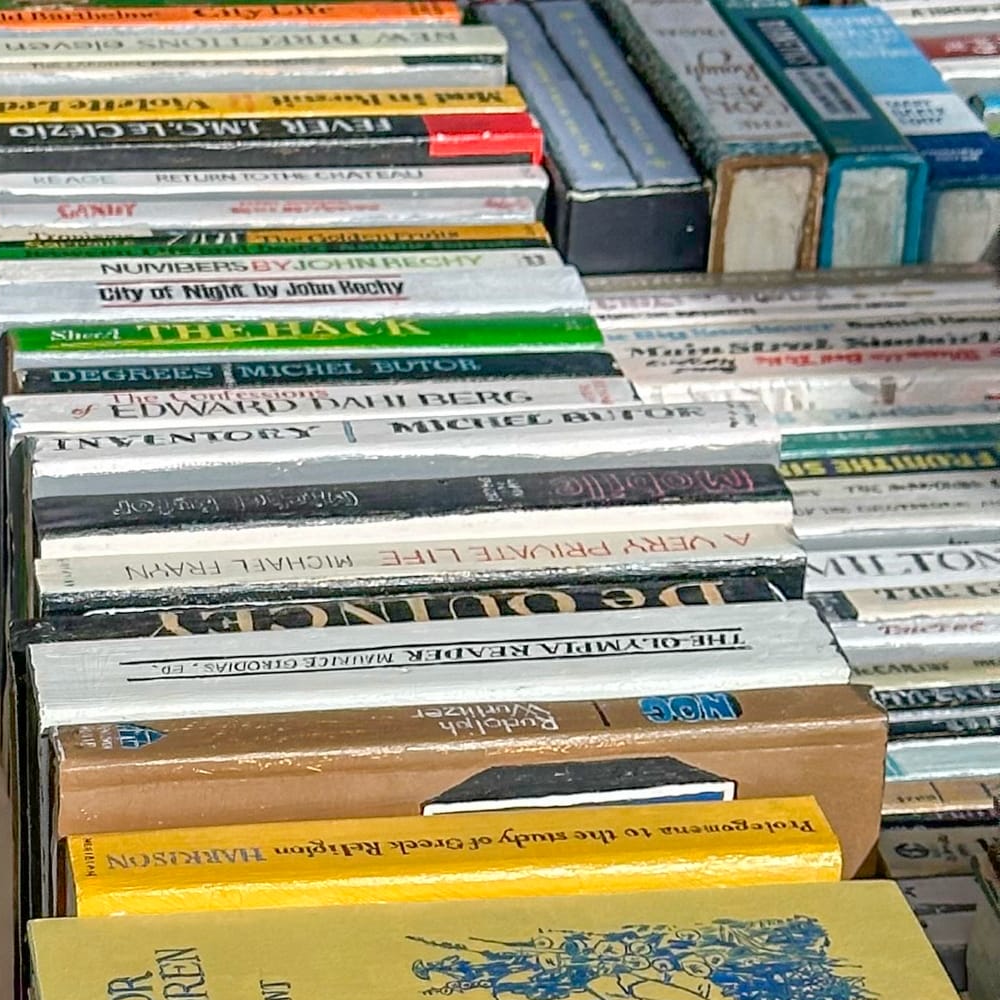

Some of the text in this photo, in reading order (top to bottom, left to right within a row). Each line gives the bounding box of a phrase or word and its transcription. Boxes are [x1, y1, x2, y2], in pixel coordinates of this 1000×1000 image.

[135, 33, 362, 53] DIRECTIONS
[376, 30, 459, 46] NEW
[283, 115, 393, 134] FEVER
[100, 254, 485, 276] NUMBERS BY JOHN RECHY
[98, 282, 145, 304] City
[149, 281, 175, 300] of
[182, 282, 247, 303] Night
[252, 280, 283, 301] by
[284, 279, 337, 298] John
[136, 318, 432, 344] THE HACK
[49, 356, 484, 385] DEGREES MICHEL BUTOR
[109, 396, 298, 421] EDWARD
[53, 424, 322, 451] INVENTORY
[391, 411, 546, 436] MICHEL
[469, 539, 614, 562] PRIVATE
[624, 535, 719, 558] VERY
[727, 532, 753, 552] A
[377, 548, 462, 568] LIFE
[539, 635, 682, 656] OLYMPIA
[690, 631, 748, 648] THE
[404, 642, 533, 662] READER
[638, 692, 737, 726] NOG
[495, 827, 569, 849] study
[573, 826, 619, 844] the
[624, 824, 654, 841] to
[656, 815, 818, 842] Prolegomena
[467, 832, 494, 851] of
[104, 845, 267, 872] HARRISON
